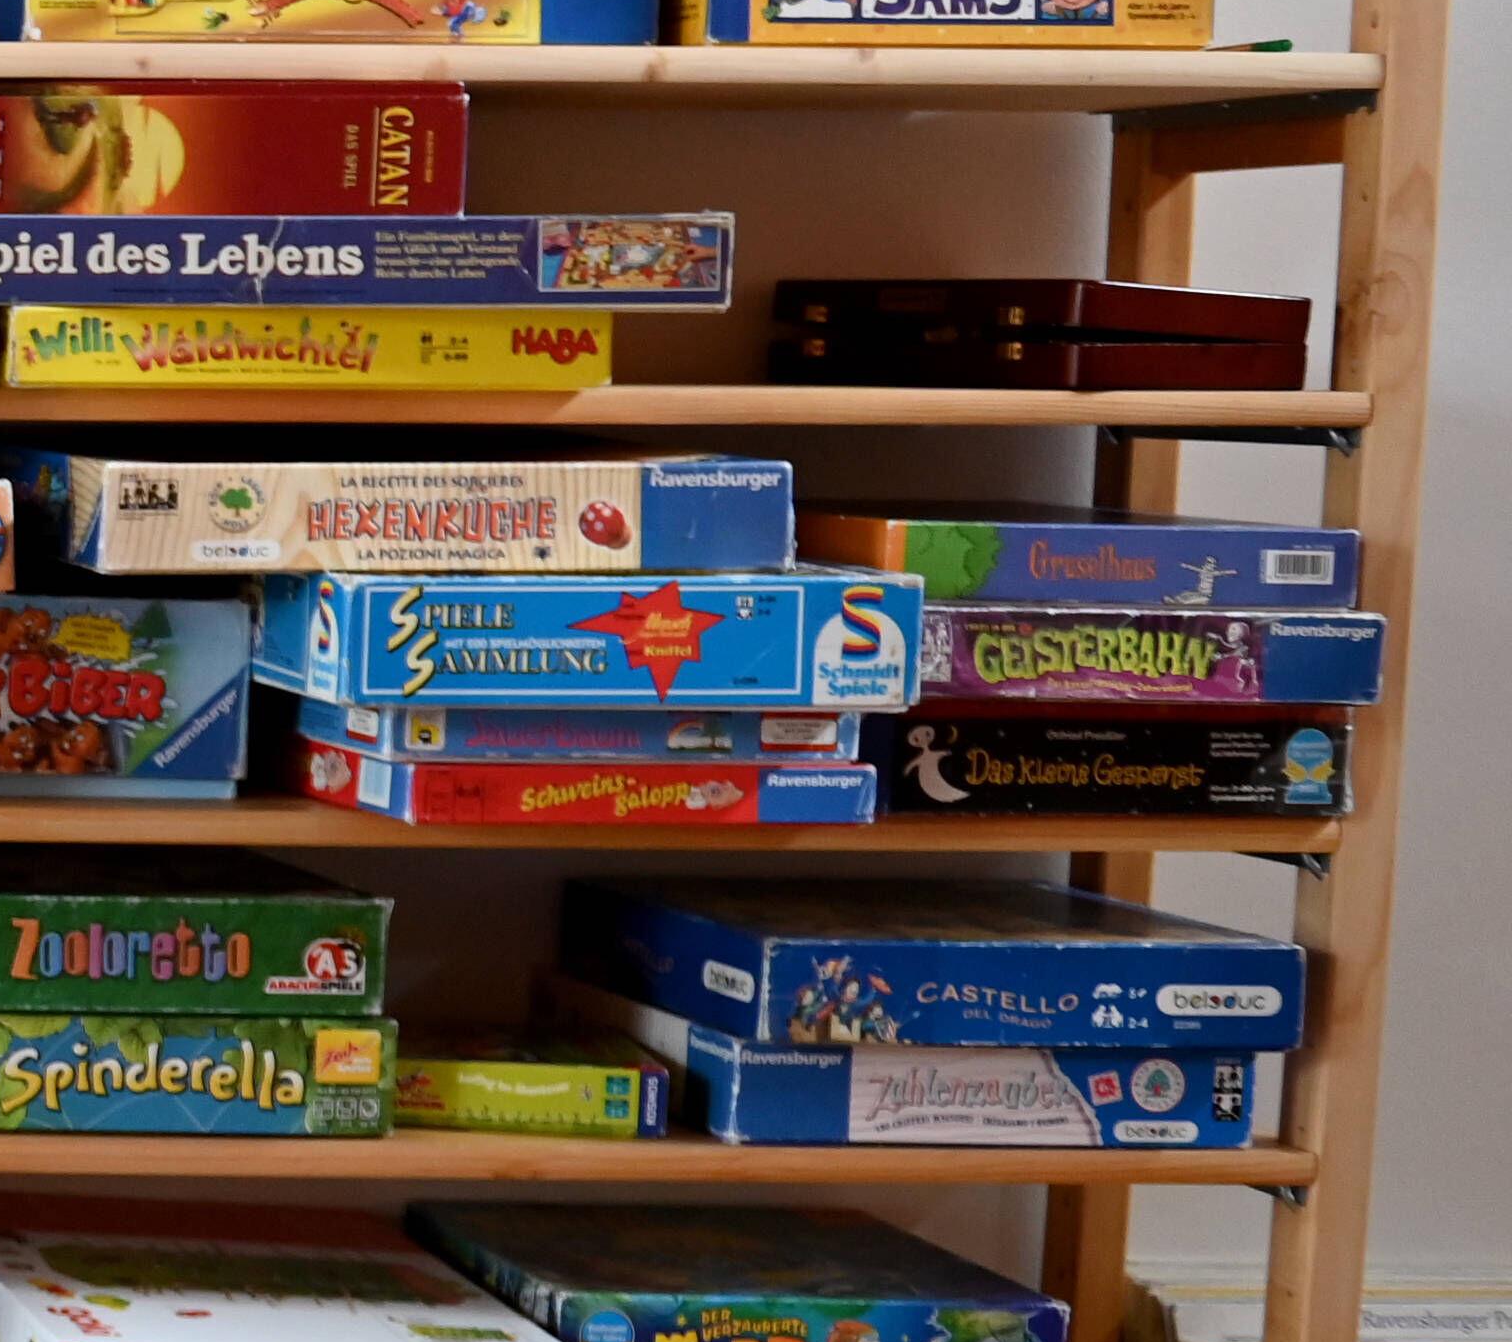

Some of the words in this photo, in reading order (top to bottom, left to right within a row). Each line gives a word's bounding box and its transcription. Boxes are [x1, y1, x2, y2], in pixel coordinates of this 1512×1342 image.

[380, 107, 414, 207] CATAN
[87, 234, 170, 275] des
[182, 234, 364, 277] Lebens
[650, 470, 781, 491] Ravensburger
[974, 624, 1219, 681] GEISTERBAHN
[11, 917, 251, 980] Zooloretto
[2, 1040, 305, 1109] Spinderella
